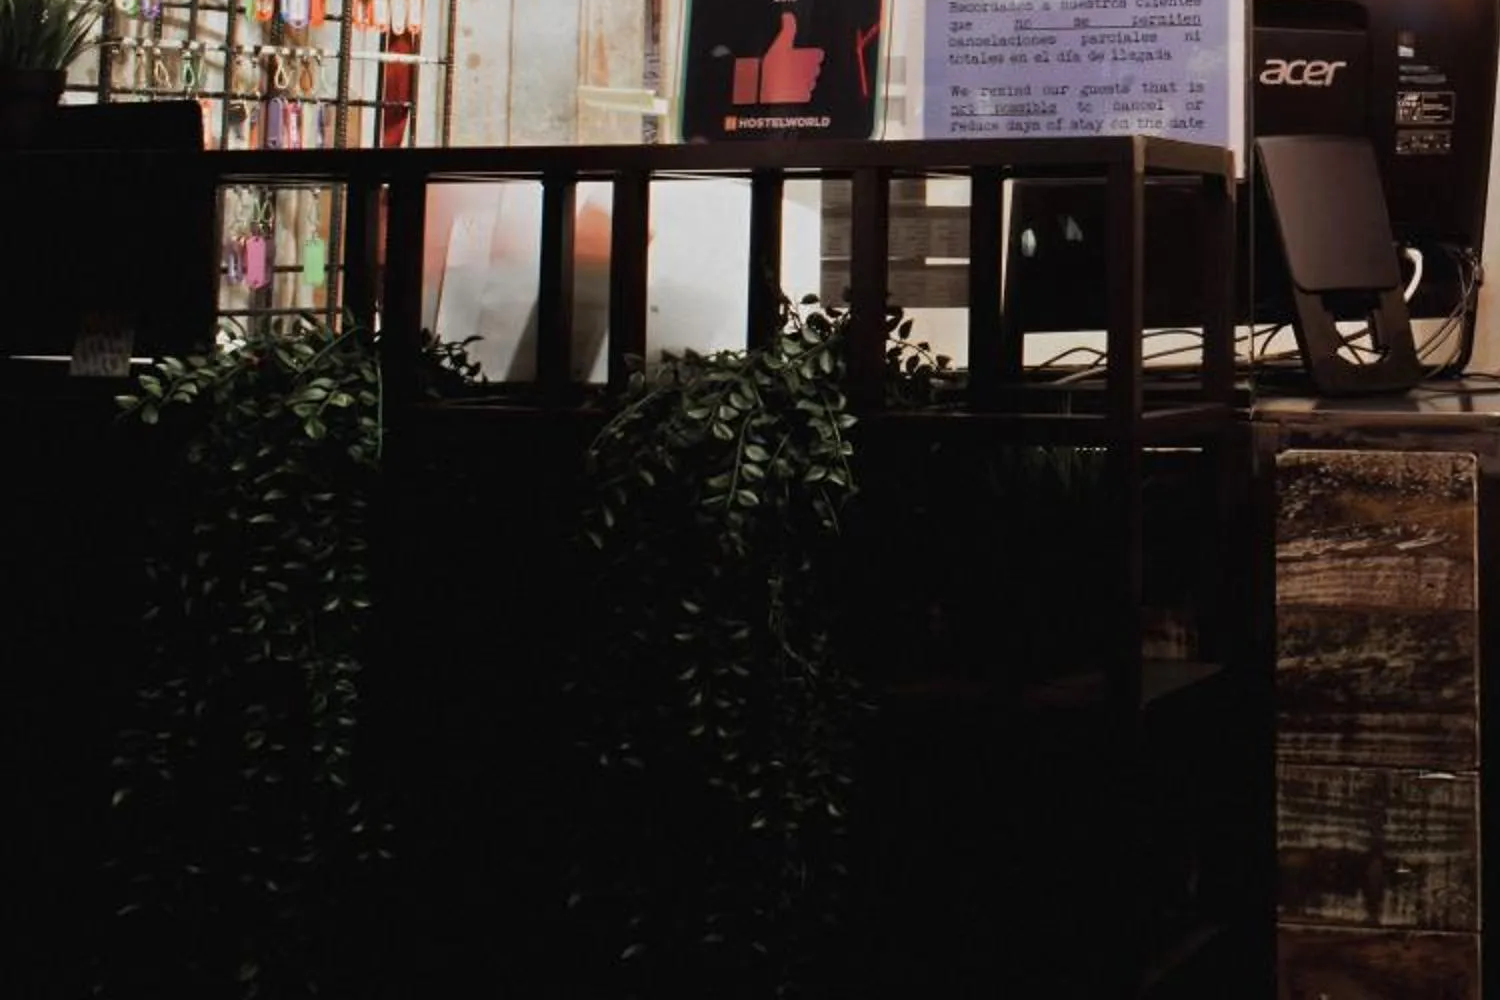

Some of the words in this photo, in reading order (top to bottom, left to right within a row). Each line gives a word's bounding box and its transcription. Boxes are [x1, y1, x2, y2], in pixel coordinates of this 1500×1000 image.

[948, 34, 1057, 47] cancelaciones
[1080, 31, 1158, 46] parciales
[1184, 29, 1202, 42] ni
[948, 51, 1004, 65] totales
[1009, 53, 1028, 63] en
[1033, 49, 1050, 63] el
[1258, 59, 1348, 87] acer
[951, 85, 970, 97] We
[1141, 82, 1178, 94] that
[1188, 81, 1205, 94] is
[1112, 99, 1165, 112] cancel
[738, 115, 832, 130] HOSTELWORLD
[1006, 119, 1042, 133] days
[1069, 118, 1104, 133] stay
